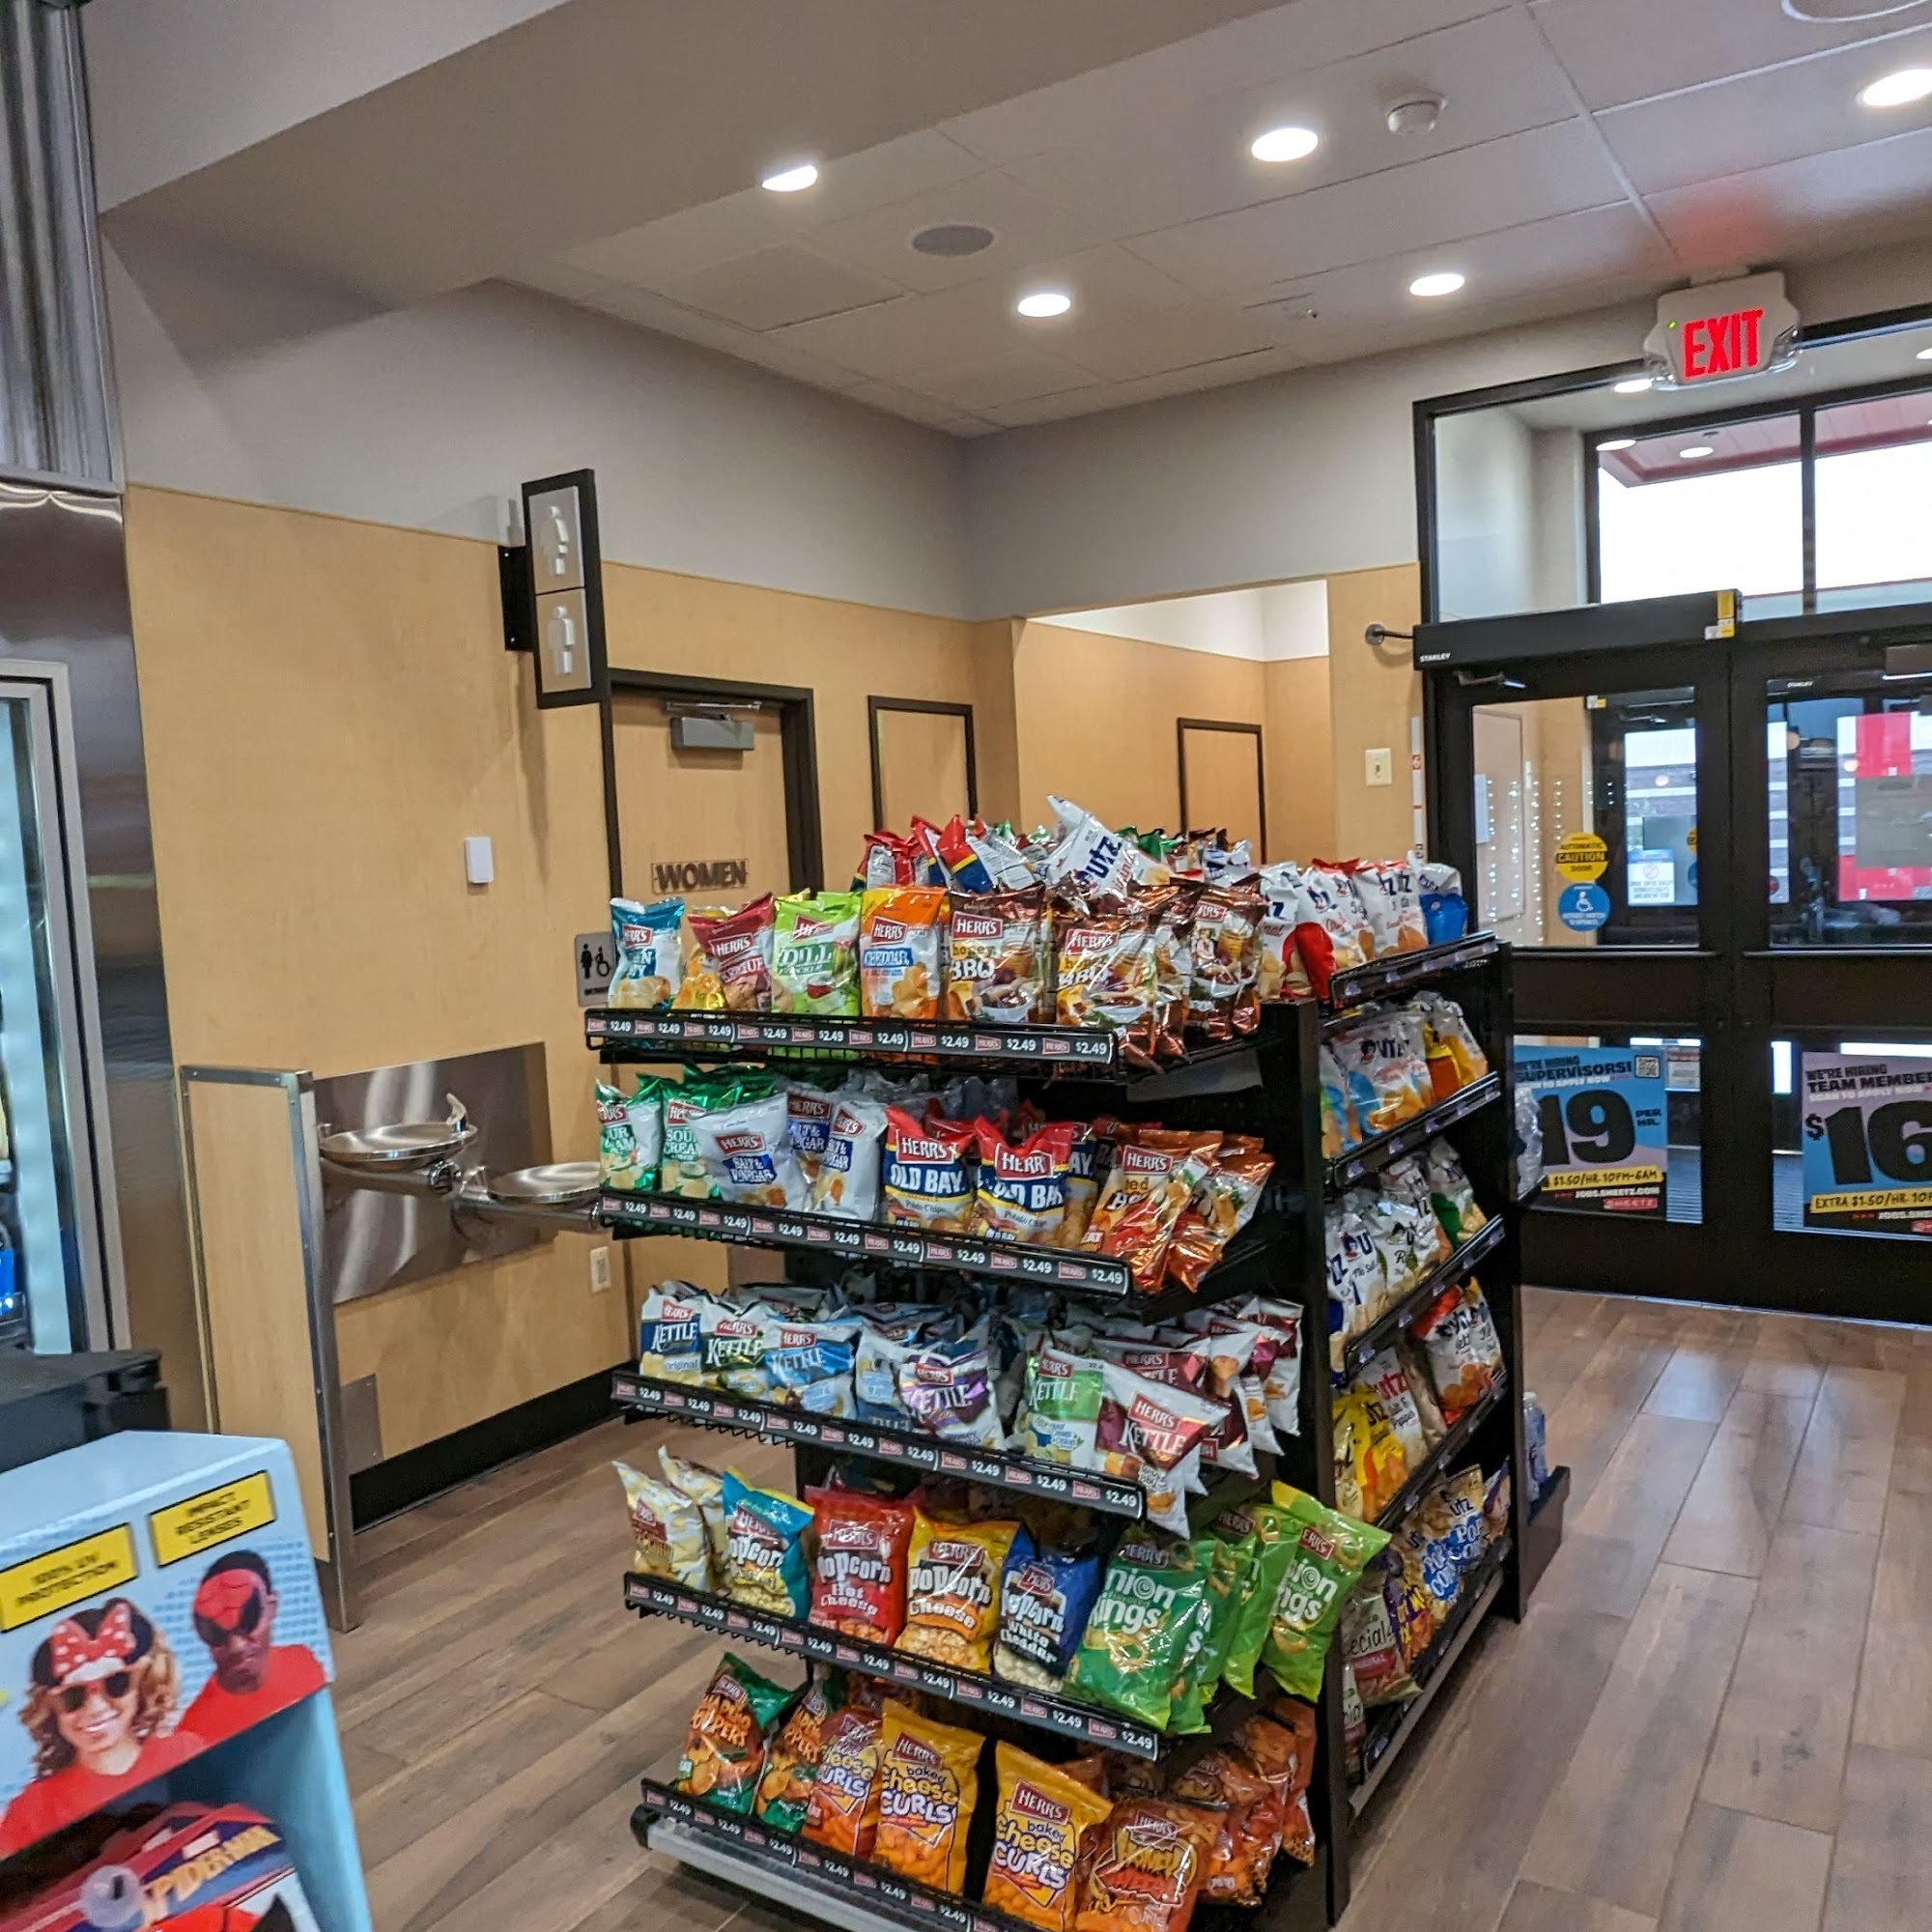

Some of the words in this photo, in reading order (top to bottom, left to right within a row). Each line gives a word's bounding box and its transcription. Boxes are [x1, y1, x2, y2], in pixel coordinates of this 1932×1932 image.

[1684, 307, 1764, 379] EXIT
[1557, 853, 1605, 863] CAUTION
[656, 861, 748, 892] WOMEN
[781, 945, 832, 966] DILL
[951, 958, 995, 980] BBQ
[611, 1020, 632, 1032] $2.49
[659, 1023, 680, 1035] $2.49
[709, 1025, 731, 1037] $2.49
[763, 1027, 787, 1039] $2.49
[819, 1030, 844, 1042] $2.49
[877, 1033, 904, 1044] $2.49
[941, 1036, 969, 1048] $2.49
[1007, 1037, 1037, 1051] $2.49
[1075, 1041, 1107, 1055] $2.49
[1516, 1062, 1632, 1083] SUPERVISORS!
[1807, 1079, 1857, 1094] TEAM
[1538, 1089, 1635, 1165] 19
[902, 1138, 947, 1158] HERR'S
[1068, 1157, 1091, 1176] AY
[1127, 1152, 1167, 1171] HERR'S
[891, 1164, 921, 1190] OLD
[925, 1170, 963, 1194] BAY
[626, 1202, 646, 1214] $2.49
[1816, 1197, 1848, 1208] EXTRA
[674, 1208, 696, 1221] $2.49
[724, 1215, 747, 1229] $2.49
[779, 1224, 803, 1237] $2.49
[835, 1232, 860, 1245] $2.49
[894, 1239, 919, 1254] $2.49
[957, 1249, 985, 1264] $2.49
[1022, 1259, 1052, 1273] $2.49
[1093, 1269, 1123, 1284] $2.49
[651, 1322, 698, 1351] KETTLE
[707, 1339, 764, 1367] KETTLE
[639, 1387, 662, 1401] $2.49
[1031, 1381, 1079, 1410] KETTLE
[688, 1398, 710, 1411] $2.49
[738, 1408, 761, 1423] $2.49
[793, 1421, 817, 1435] $2.49
[848, 1434, 874, 1448] $2.49
[1119, 1419, 1186, 1457] KETTLE
[908, 1447, 934, 1462] $2.49
[972, 1461, 1000, 1476] $2.49
[1037, 1475, 1066, 1491] $2.49
[1105, 1491, 1137, 1507] $2.49
[832, 1583, 865, 1599] Hot
[1105, 1568, 1176, 1609] nion
[820, 1595, 878, 1616] Cheese
[909, 1599, 976, 1630] Cheese
[864, 1654, 890, 1670] $2.49
[923, 1672, 950, 1689] $2.49
[987, 1690, 1015, 1708] $2.49
[1053, 1710, 1082, 1728] $2.49
[1122, 1731, 1152, 1749] $2.49
[907, 1766, 947, 1784] baked
[880, 1790, 952, 1825] CURLS
[1018, 1790, 1063, 1819] HERR'S
[1027, 1820, 1067, 1841] baked
[993, 1840, 1068, 1889] CURLS
